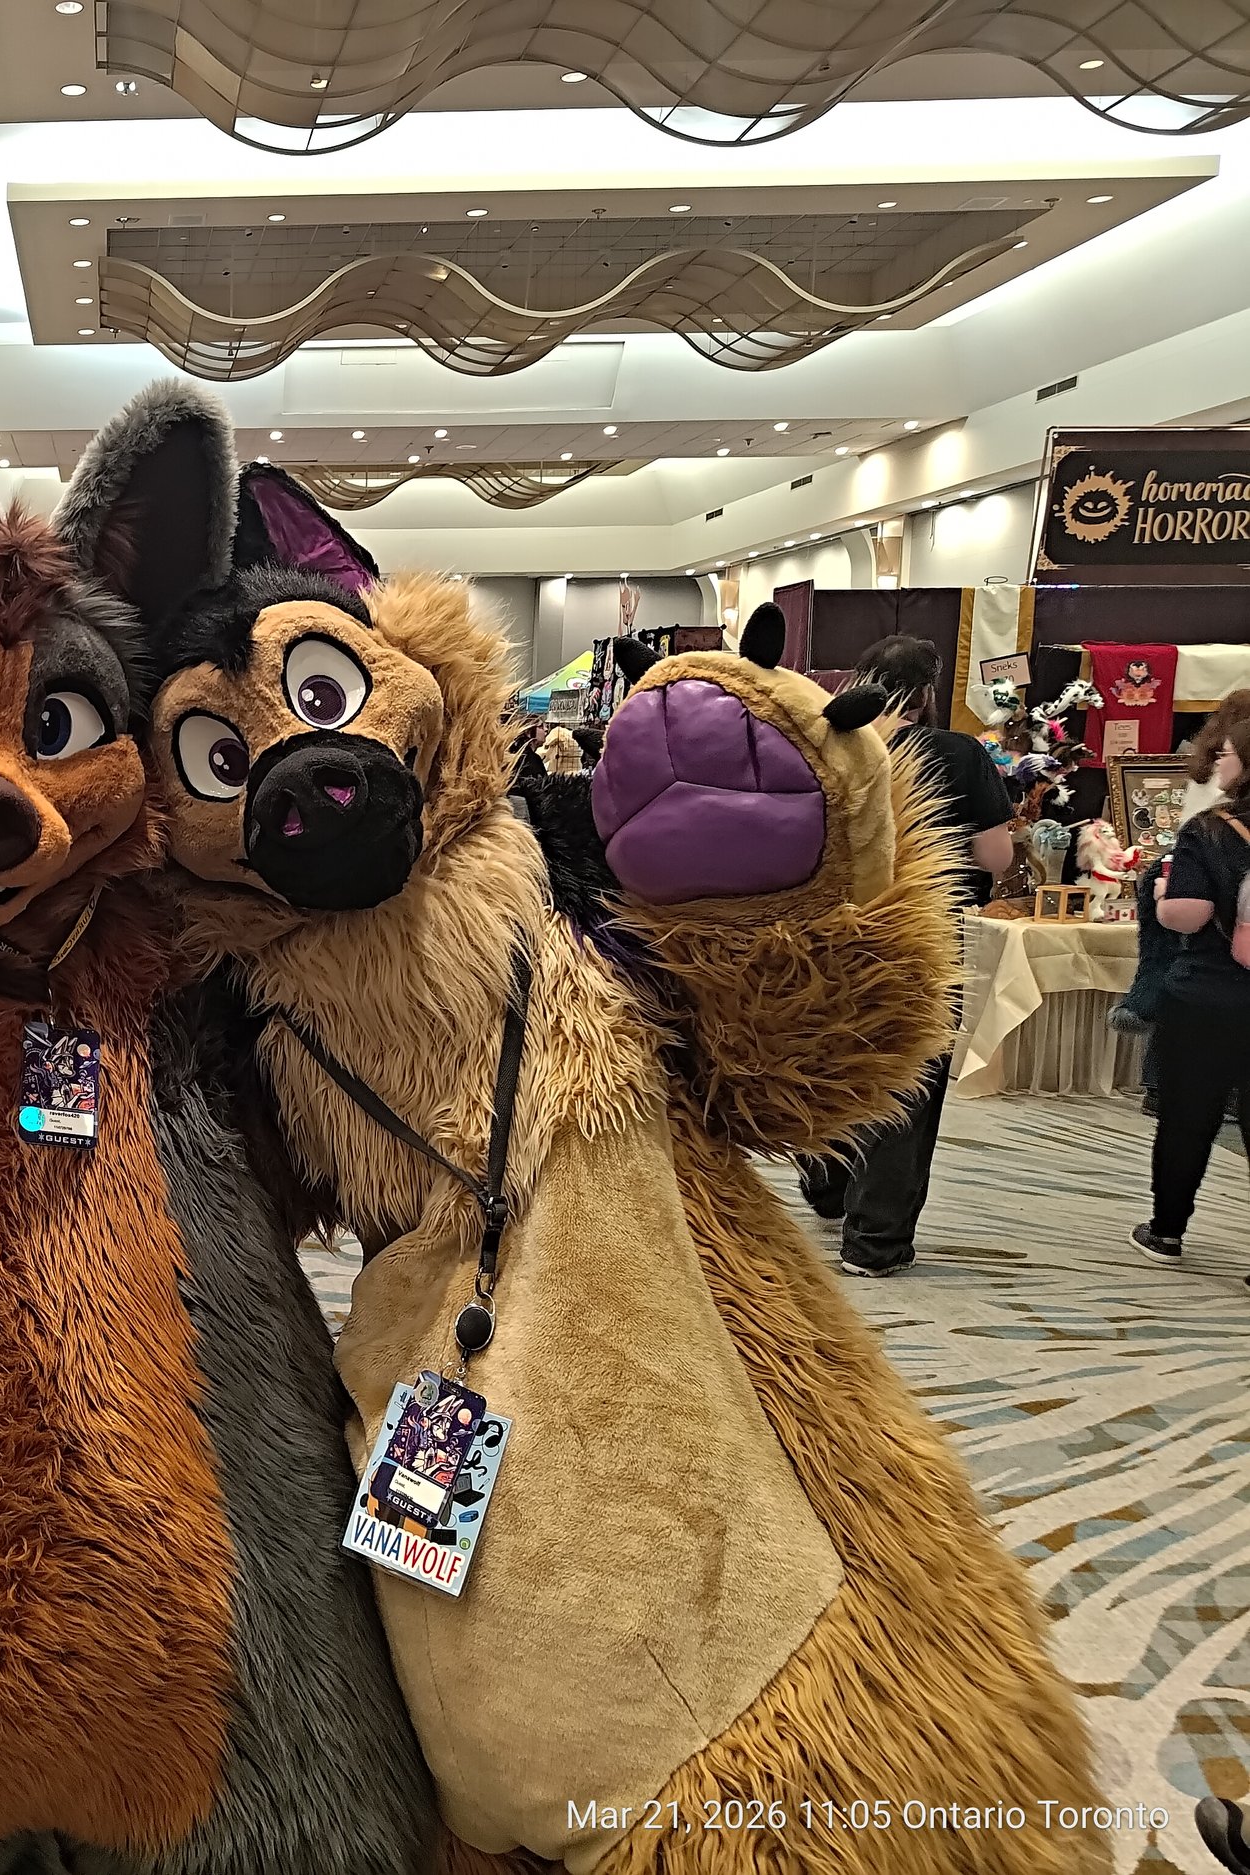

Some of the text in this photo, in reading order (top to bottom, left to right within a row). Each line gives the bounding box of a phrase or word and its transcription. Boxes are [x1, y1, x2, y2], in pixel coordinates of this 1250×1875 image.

[1141, 470, 1250, 504] homema
[990, 660, 1018, 673] Sneks
[45, 1134, 84, 1145] GUEST
[391, 1496, 427, 1519] GUEST
[351, 1513, 462, 1584] VANAWOLF
